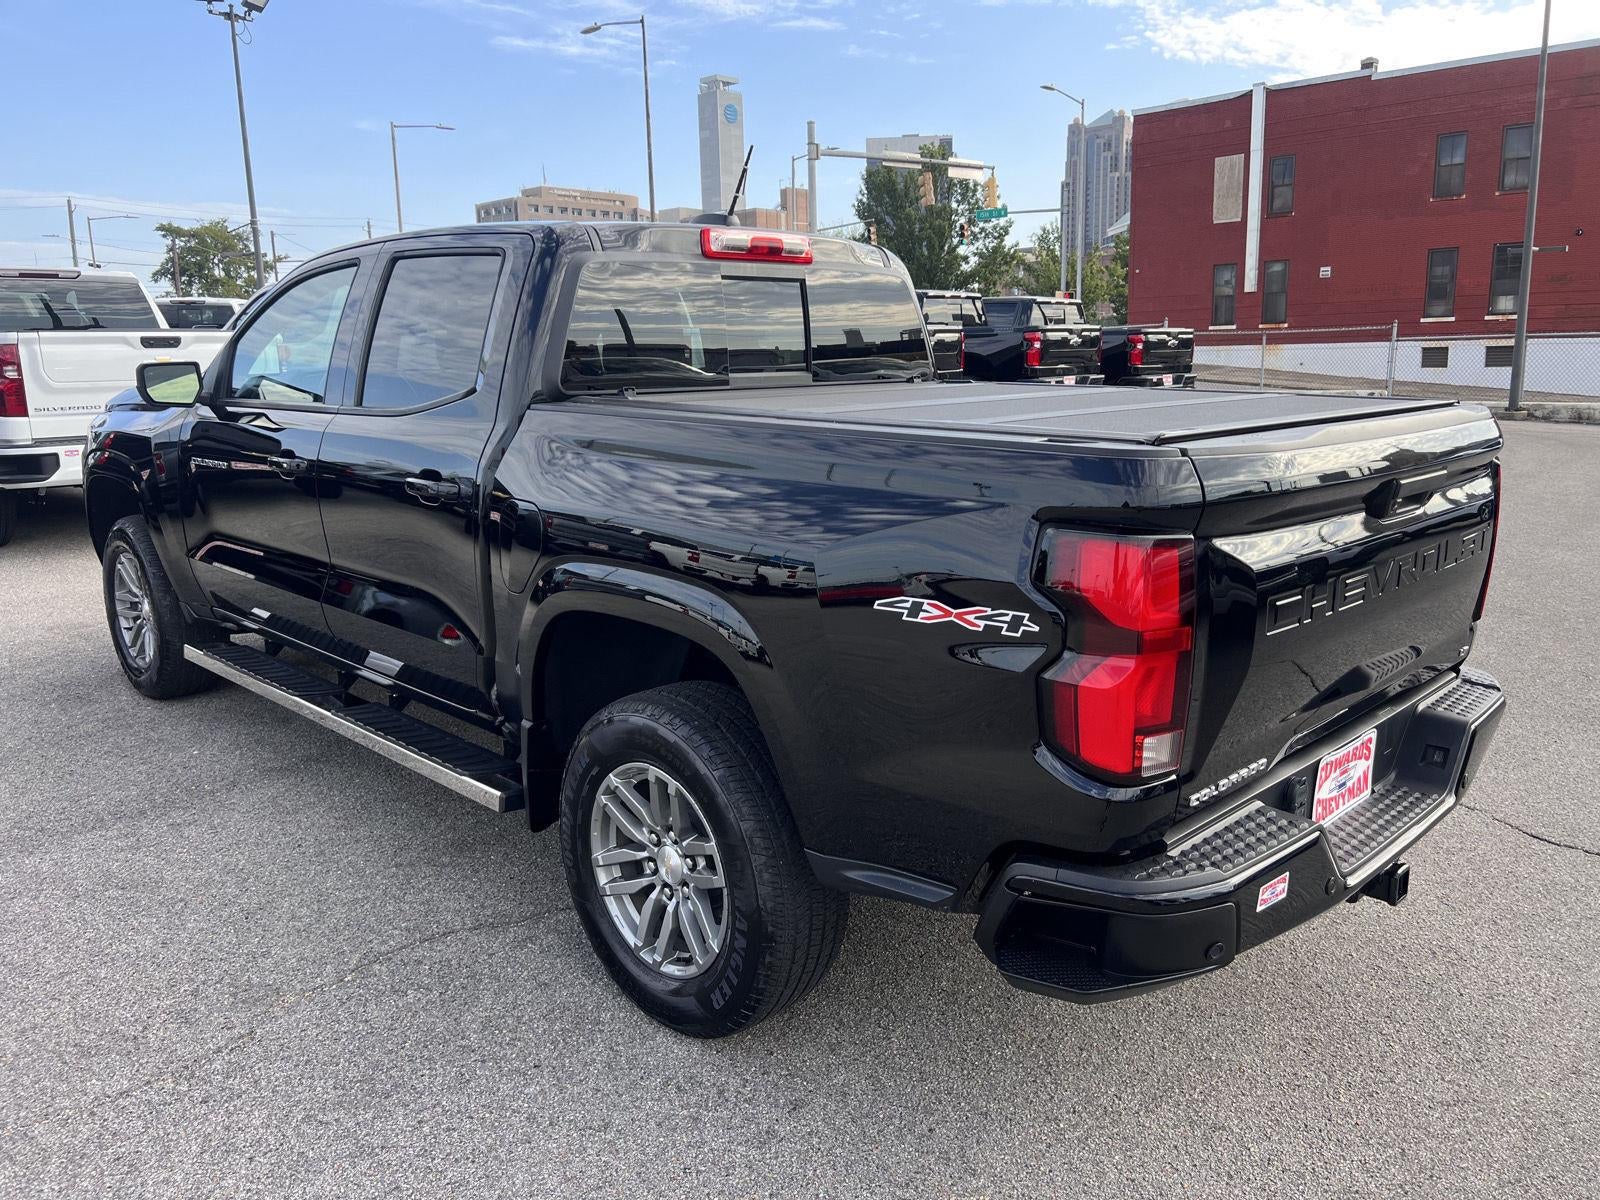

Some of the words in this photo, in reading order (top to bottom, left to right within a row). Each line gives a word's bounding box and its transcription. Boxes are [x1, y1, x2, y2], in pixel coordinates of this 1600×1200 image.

[1266, 521, 1492, 635] CHEVROLET
[1189, 758, 1267, 807] COLORADO
[1315, 764, 1370, 823] CHEVYMAN
[1317, 736, 1373, 793] EDWARDS
[710, 872, 749, 1010] ANGLER
